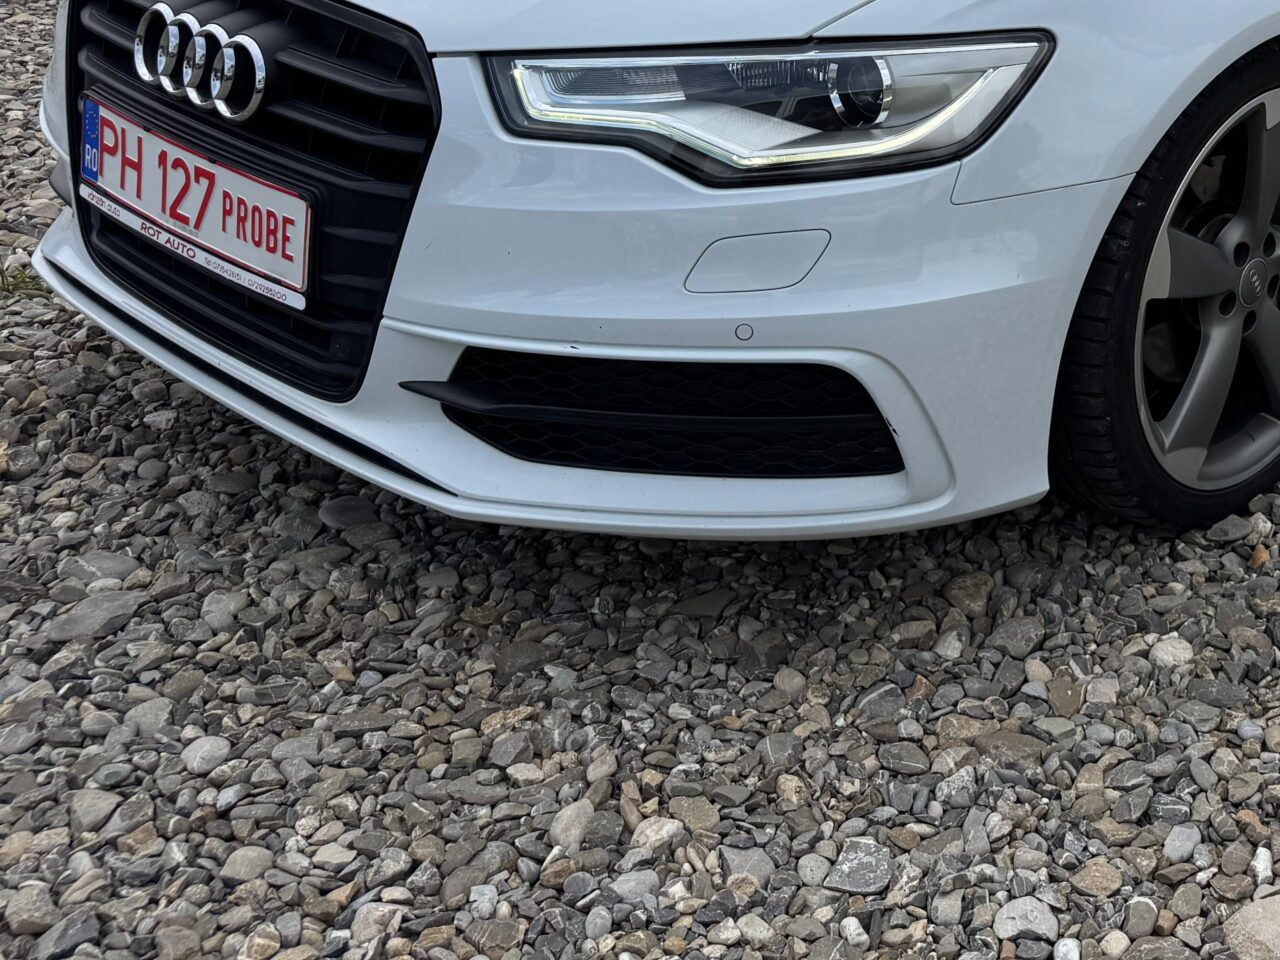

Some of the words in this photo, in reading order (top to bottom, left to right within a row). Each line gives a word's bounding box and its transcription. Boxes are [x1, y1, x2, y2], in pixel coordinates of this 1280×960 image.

[84, 143, 98, 172] RO
[98, 112, 143, 201] PH
[157, 149, 216, 231] 127
[222, 188, 296, 263] PROBE
[141, 222, 163, 241] ROT
[165, 237, 196, 259] AUTO
